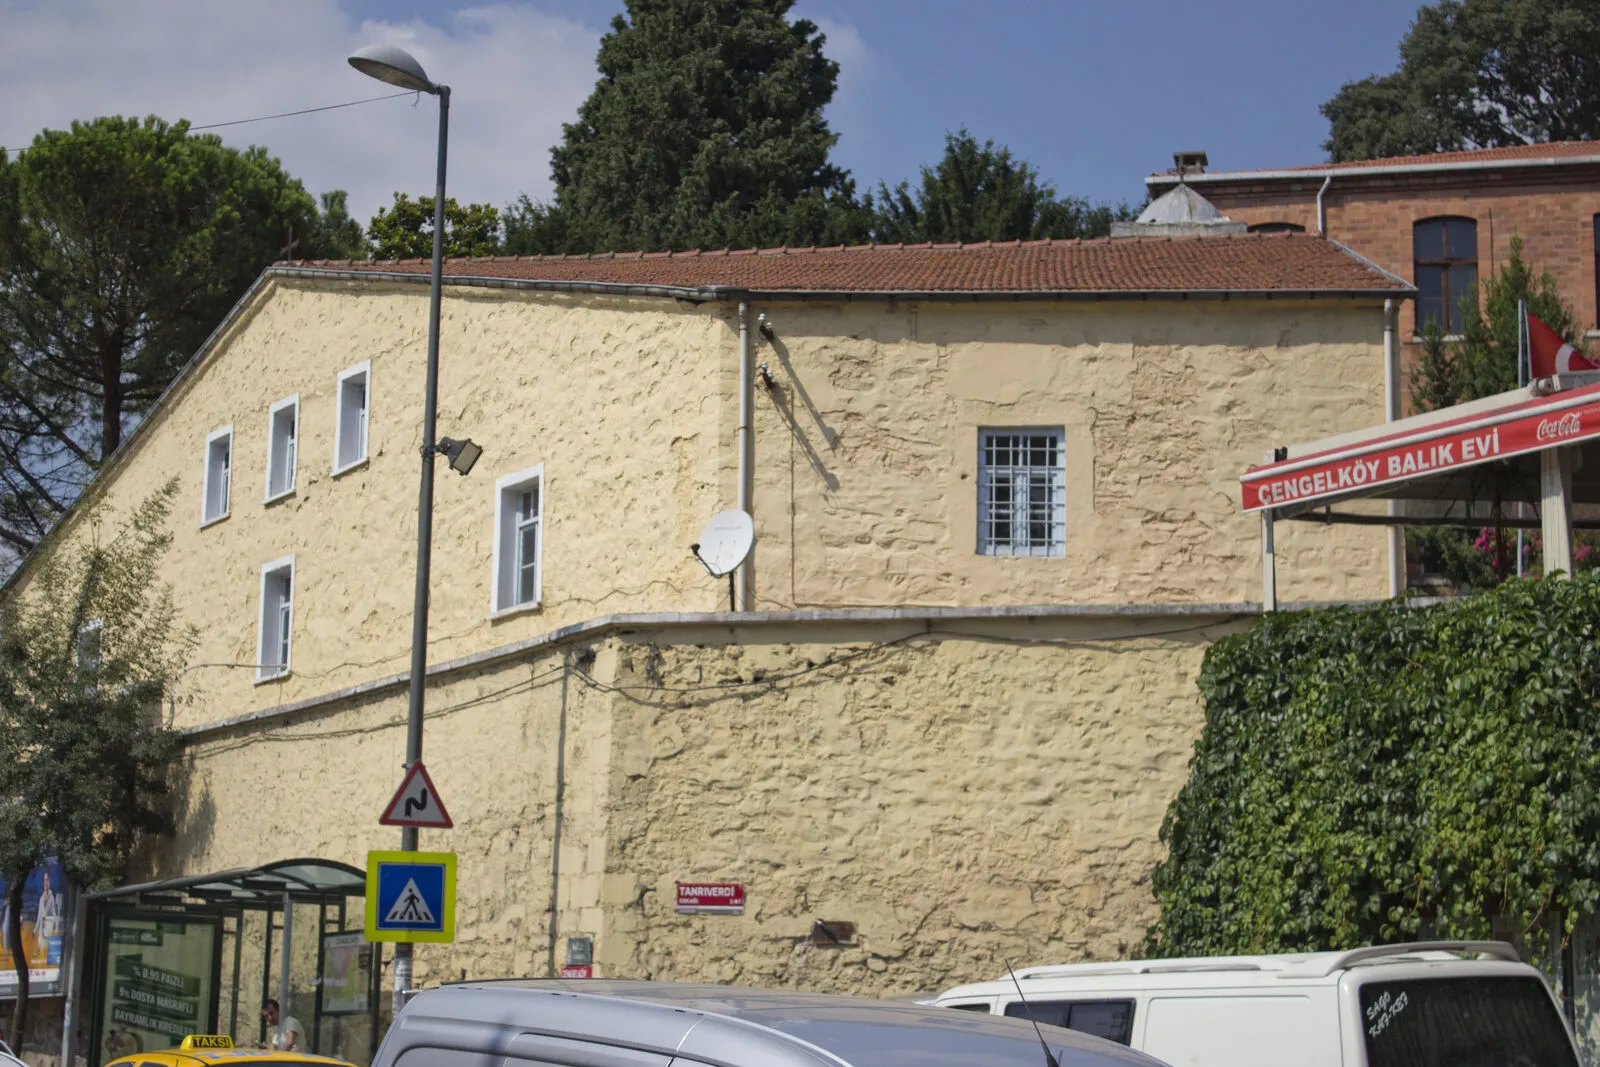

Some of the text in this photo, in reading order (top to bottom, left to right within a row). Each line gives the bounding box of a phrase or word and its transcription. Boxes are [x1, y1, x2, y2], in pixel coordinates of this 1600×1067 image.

[1537, 412, 1580, 441] Coca-Cola
[1258, 428, 1499, 506] ÇENGELKÖY BALIK EVİ
